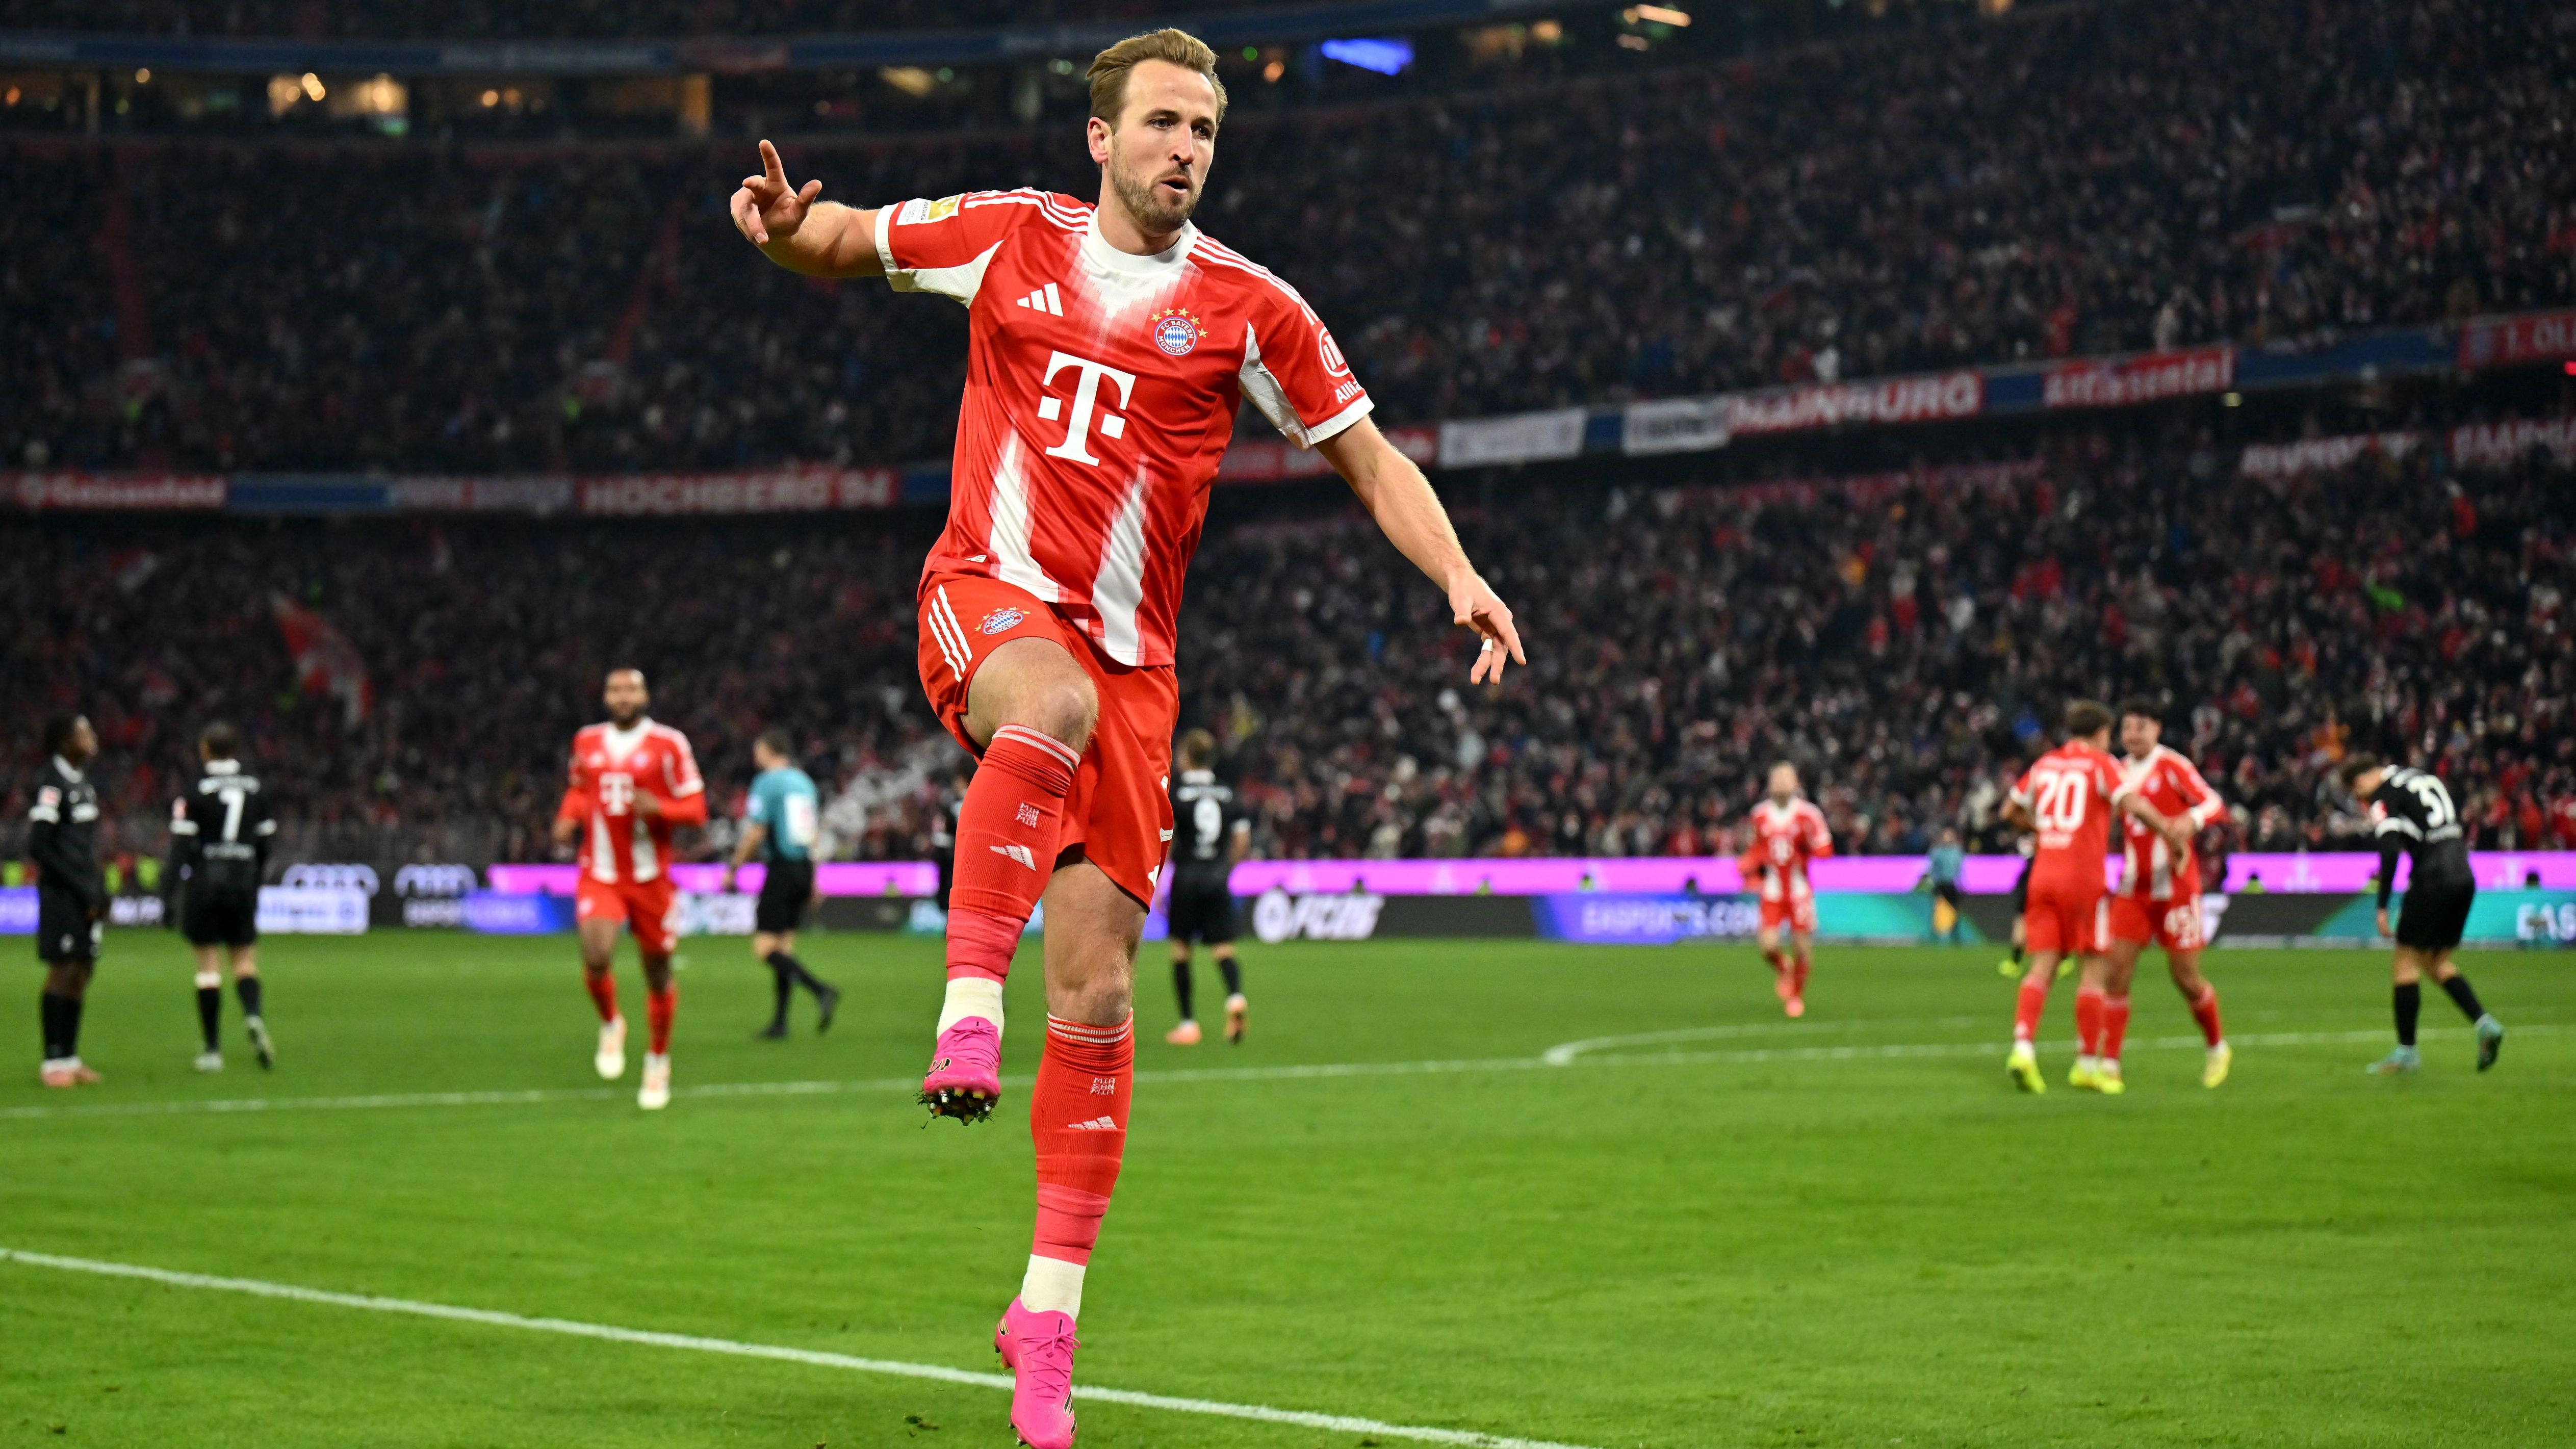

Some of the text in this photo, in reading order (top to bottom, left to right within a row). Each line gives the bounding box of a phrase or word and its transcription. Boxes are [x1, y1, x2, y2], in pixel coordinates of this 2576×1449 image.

[1161, 320, 1194, 339] FC BAYERN
[1037, 350, 1136, 466] T
[1193, 796, 1222, 844] 9
[2036, 771, 2089, 831] 20
